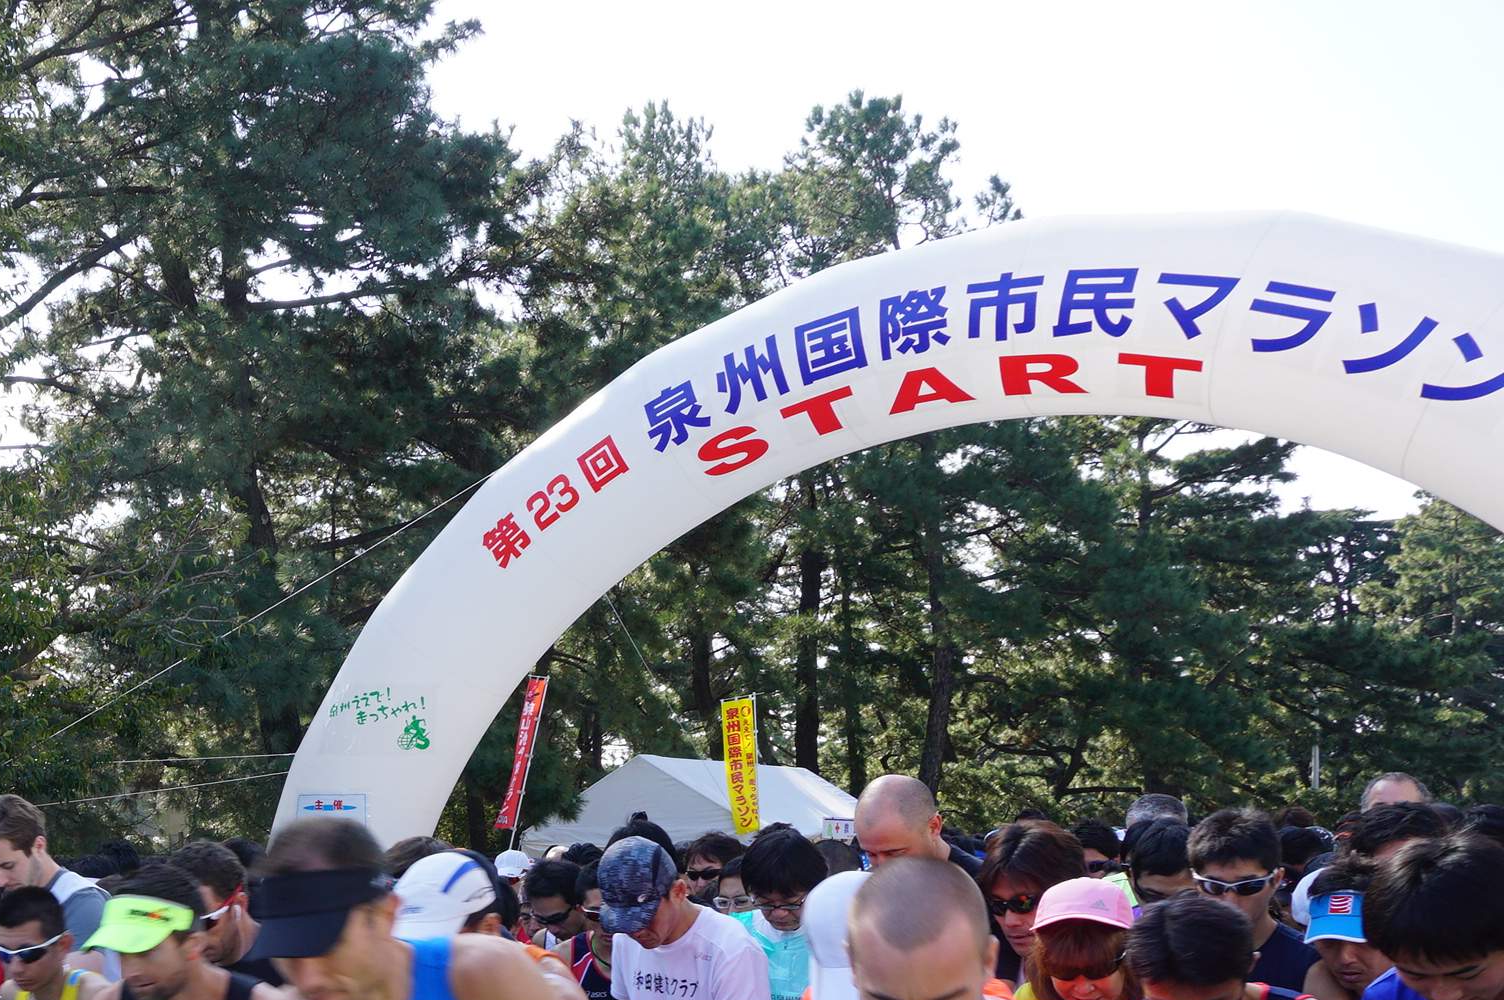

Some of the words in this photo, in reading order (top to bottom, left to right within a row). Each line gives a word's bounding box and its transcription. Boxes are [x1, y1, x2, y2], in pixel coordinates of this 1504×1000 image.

[643, 267, 1504, 453] 泉州国際市民マラソン
[698, 353, 1204, 477] START
[482, 434, 630, 569] 第23回
[726, 708, 752, 828] 泉州国際市民マラソン
